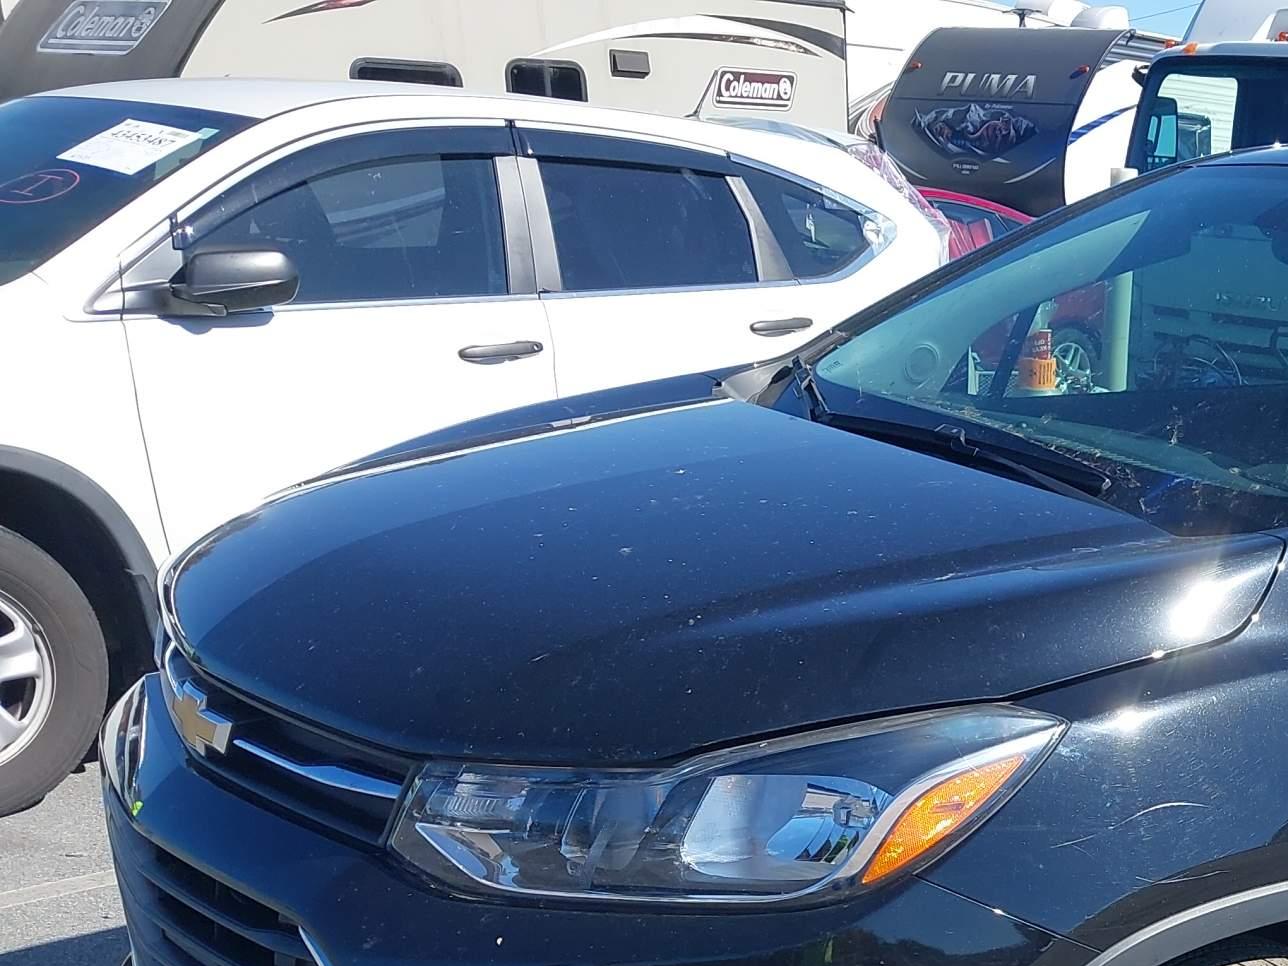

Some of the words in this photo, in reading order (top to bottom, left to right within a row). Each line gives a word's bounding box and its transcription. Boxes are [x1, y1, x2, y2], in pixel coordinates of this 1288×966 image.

[56, 5, 136, 38] Coleman
[720, 72, 779, 99] Coleman
[937, 71, 1037, 98] PUMA
